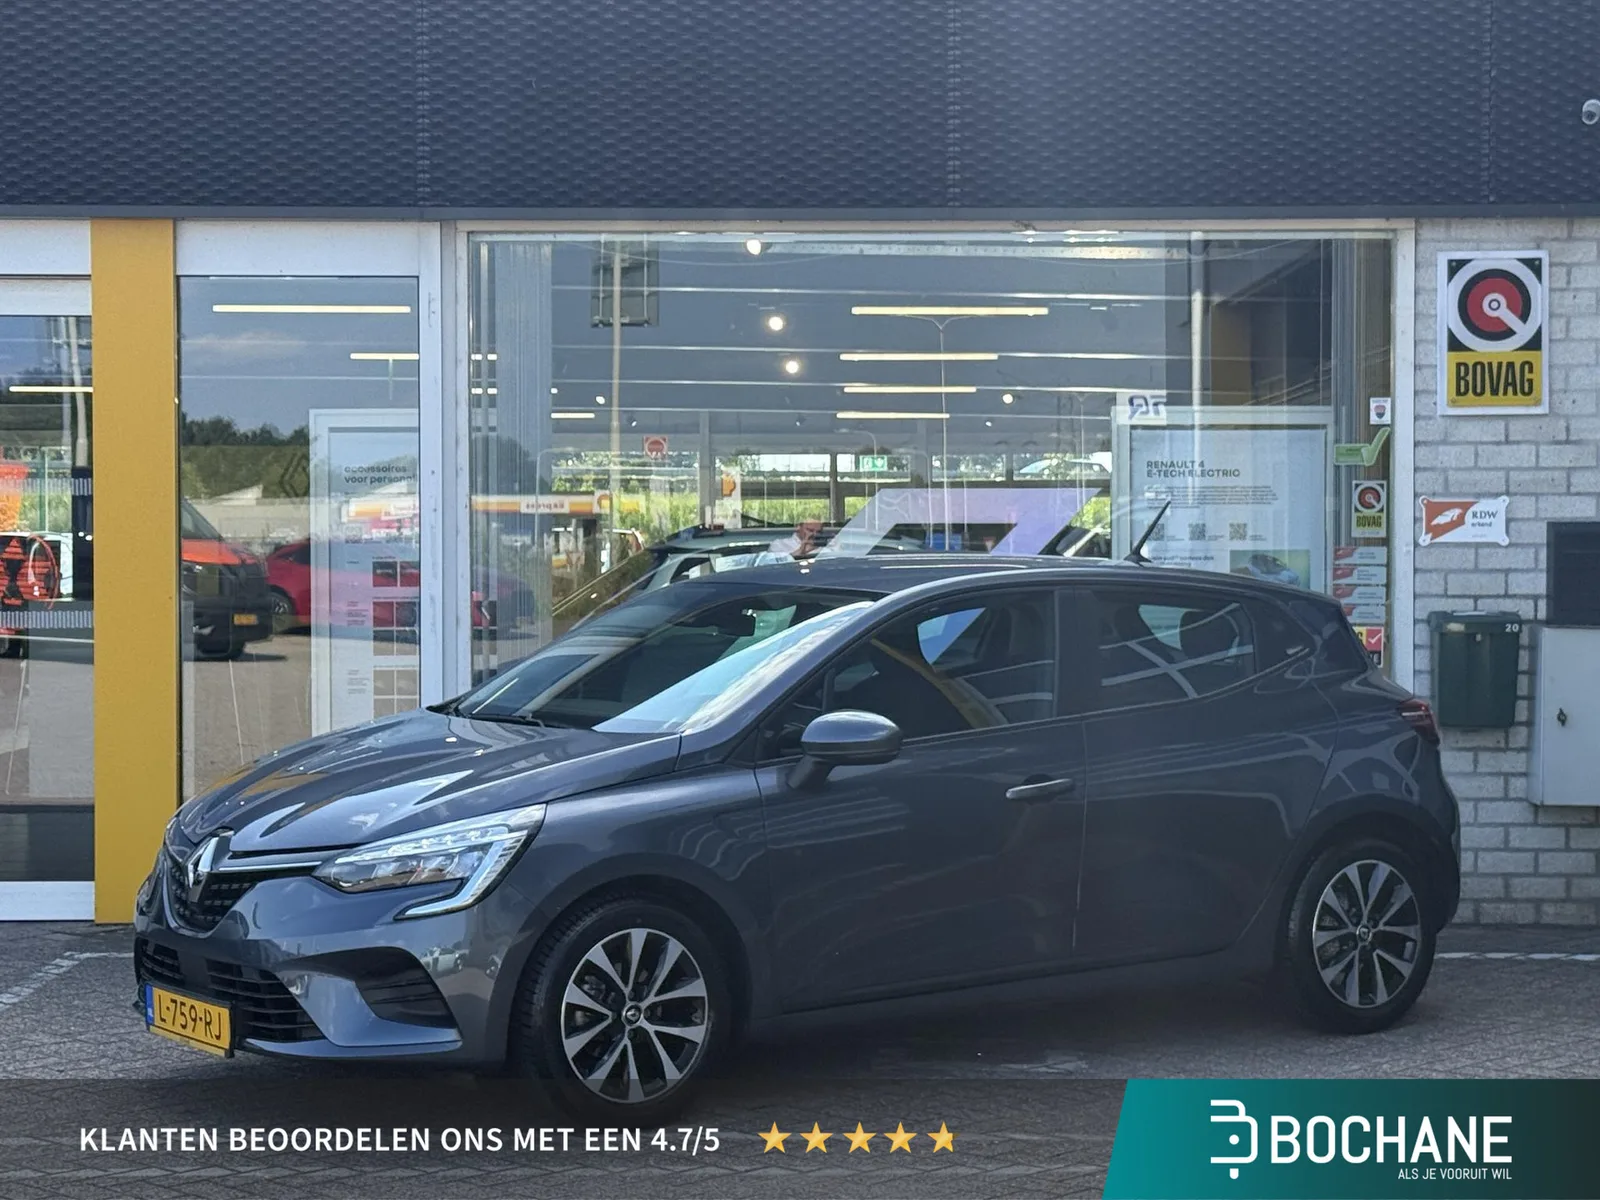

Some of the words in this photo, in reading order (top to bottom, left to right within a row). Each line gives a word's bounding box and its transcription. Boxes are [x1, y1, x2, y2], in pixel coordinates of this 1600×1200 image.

[1456, 361, 1534, 397] BOVAG
[1146, 461, 1195, 469] RENAULT
[1146, 470, 1186, 478] E-TECH
[1188, 469, 1241, 478] ELECTRIC
[1472, 510, 1499, 520] RDW
[1356, 515, 1382, 528] BOVAG
[1505, 623, 1519, 632] 20
[157, 994, 222, 1041] L-759-RJ
